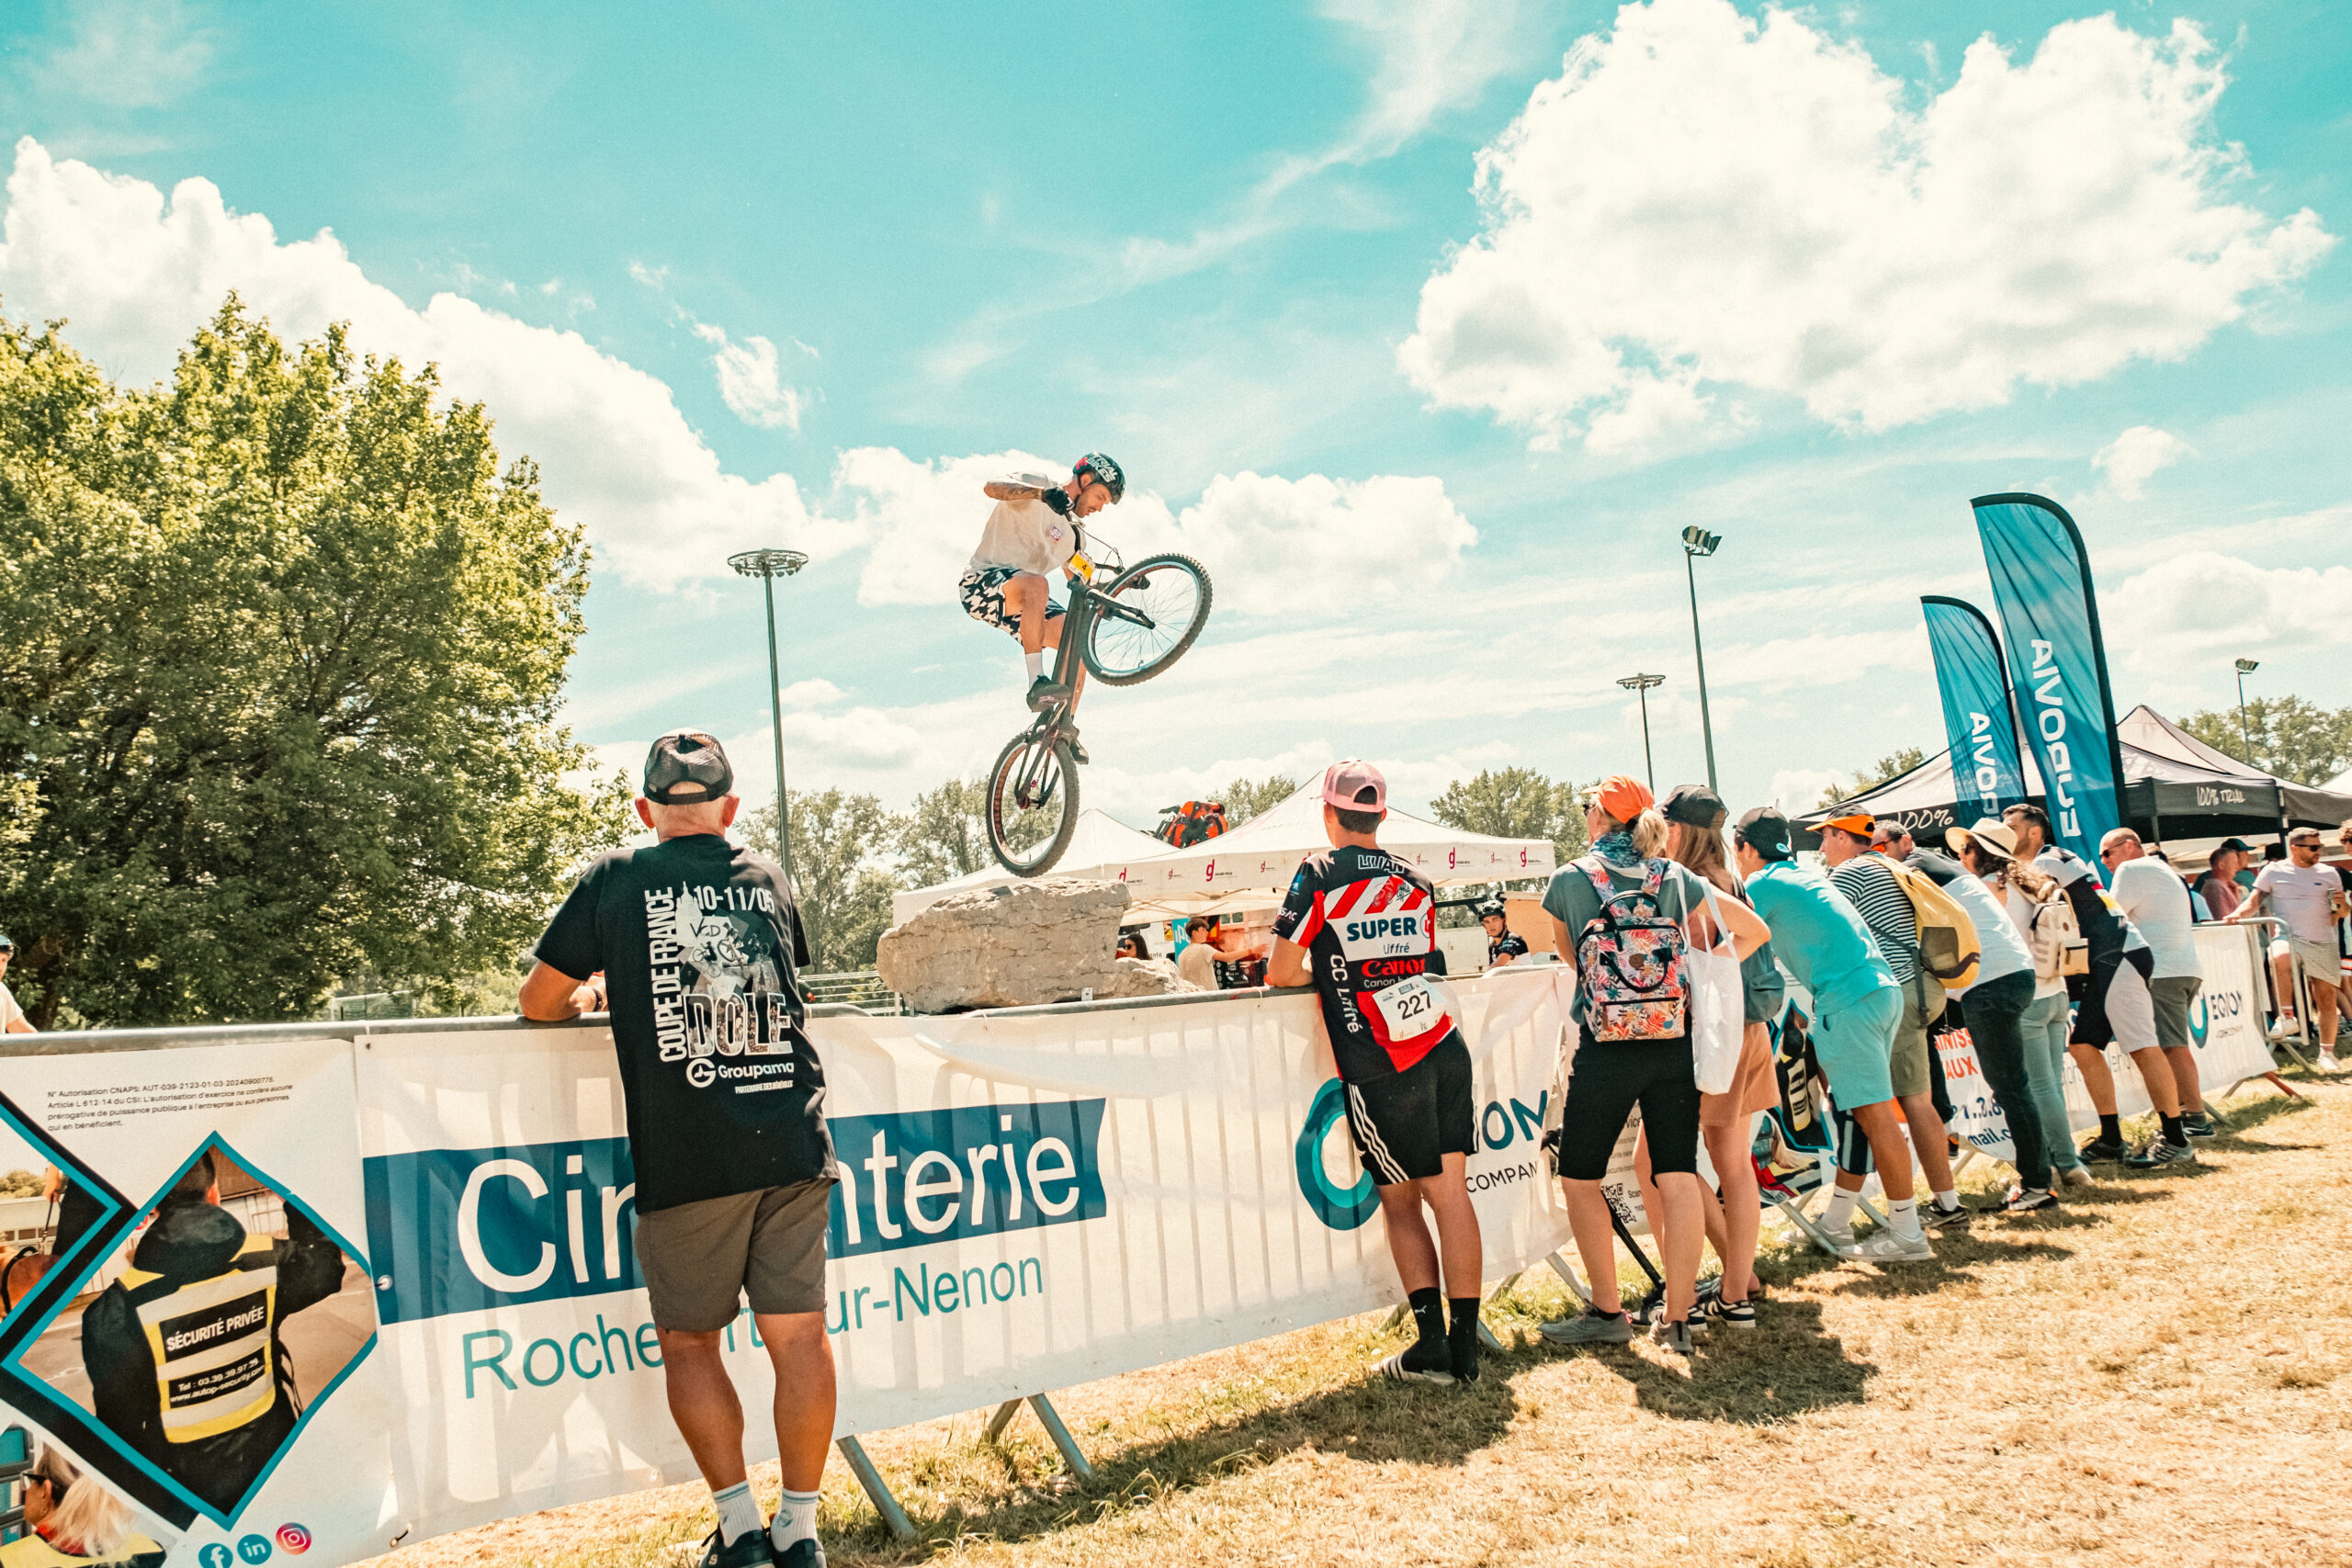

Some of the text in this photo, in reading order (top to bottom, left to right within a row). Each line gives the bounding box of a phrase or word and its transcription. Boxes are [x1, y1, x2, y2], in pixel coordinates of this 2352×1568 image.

[693, 886, 775, 914] 10-11/05
[1346, 917, 1418, 942] SUPER
[1383, 942, 1410, 955] Liffré
[644, 886, 687, 1063] COUPE DE FRANCE
[1330, 954, 1363, 1034] CC Liffré
[1396, 990, 1431, 1021] 227
[683, 992, 793, 1058] DOLE
[718, 1062, 795, 1079] Groupama
[59, 1089, 108, 1098] Autorisation
[109, 1107, 151, 1117] puissance
[152, 1104, 187, 1114] publique
[255, 1094, 290, 1104] personnes
[48, 1123, 62, 1132] qui
[458, 1113, 1080, 1293] Cinterie
[166, 1305, 265, 1352] SÉCURITÉ PRIVÉE
